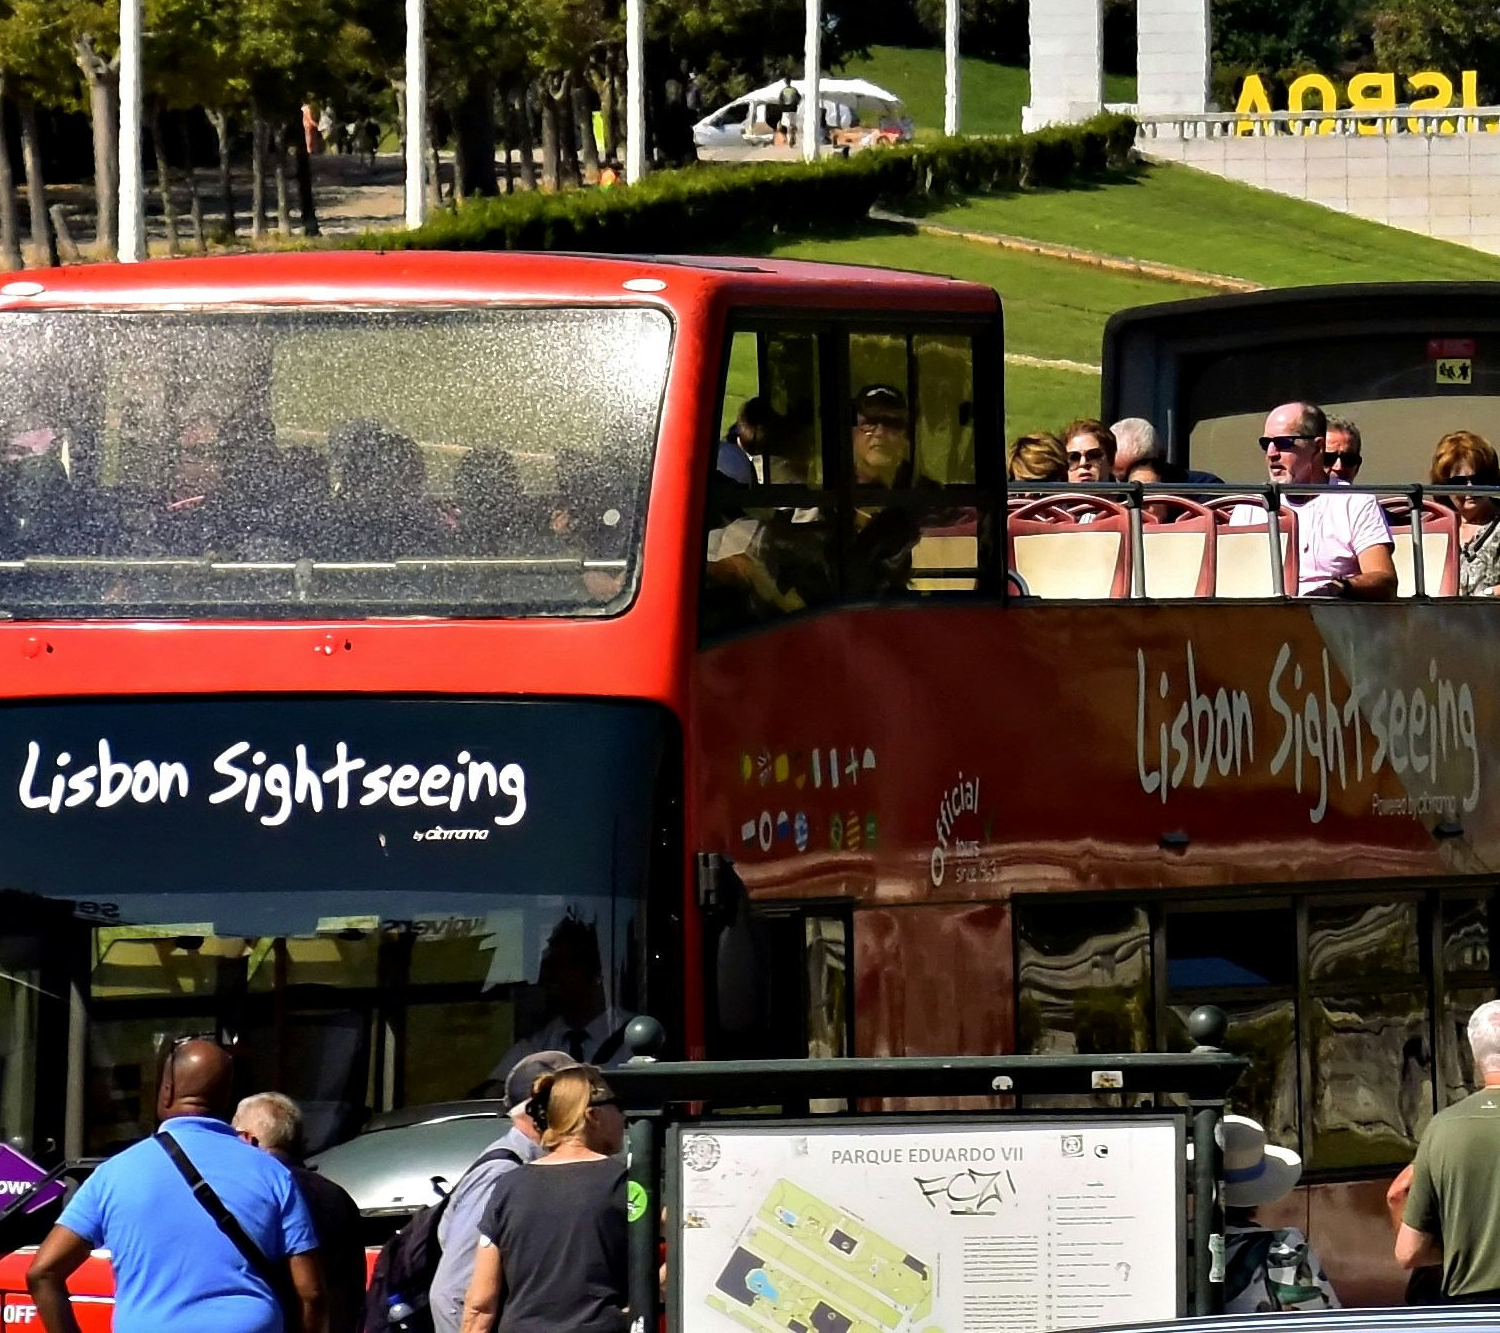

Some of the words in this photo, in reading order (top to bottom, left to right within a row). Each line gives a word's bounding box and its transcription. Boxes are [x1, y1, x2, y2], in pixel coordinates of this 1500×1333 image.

[1136, 638, 1254, 805] Lisbon
[1268, 638, 1481, 824] Sightseeing
[18, 738, 189, 813] Lisbon
[208, 740, 527, 826] Sightseeing
[831, 1147, 903, 1166] PARQUE
[908, 1146, 996, 1164] EDUARDO
[1001, 1146, 1024, 1162] VII
[3, 1304, 38, 1324] OFF
